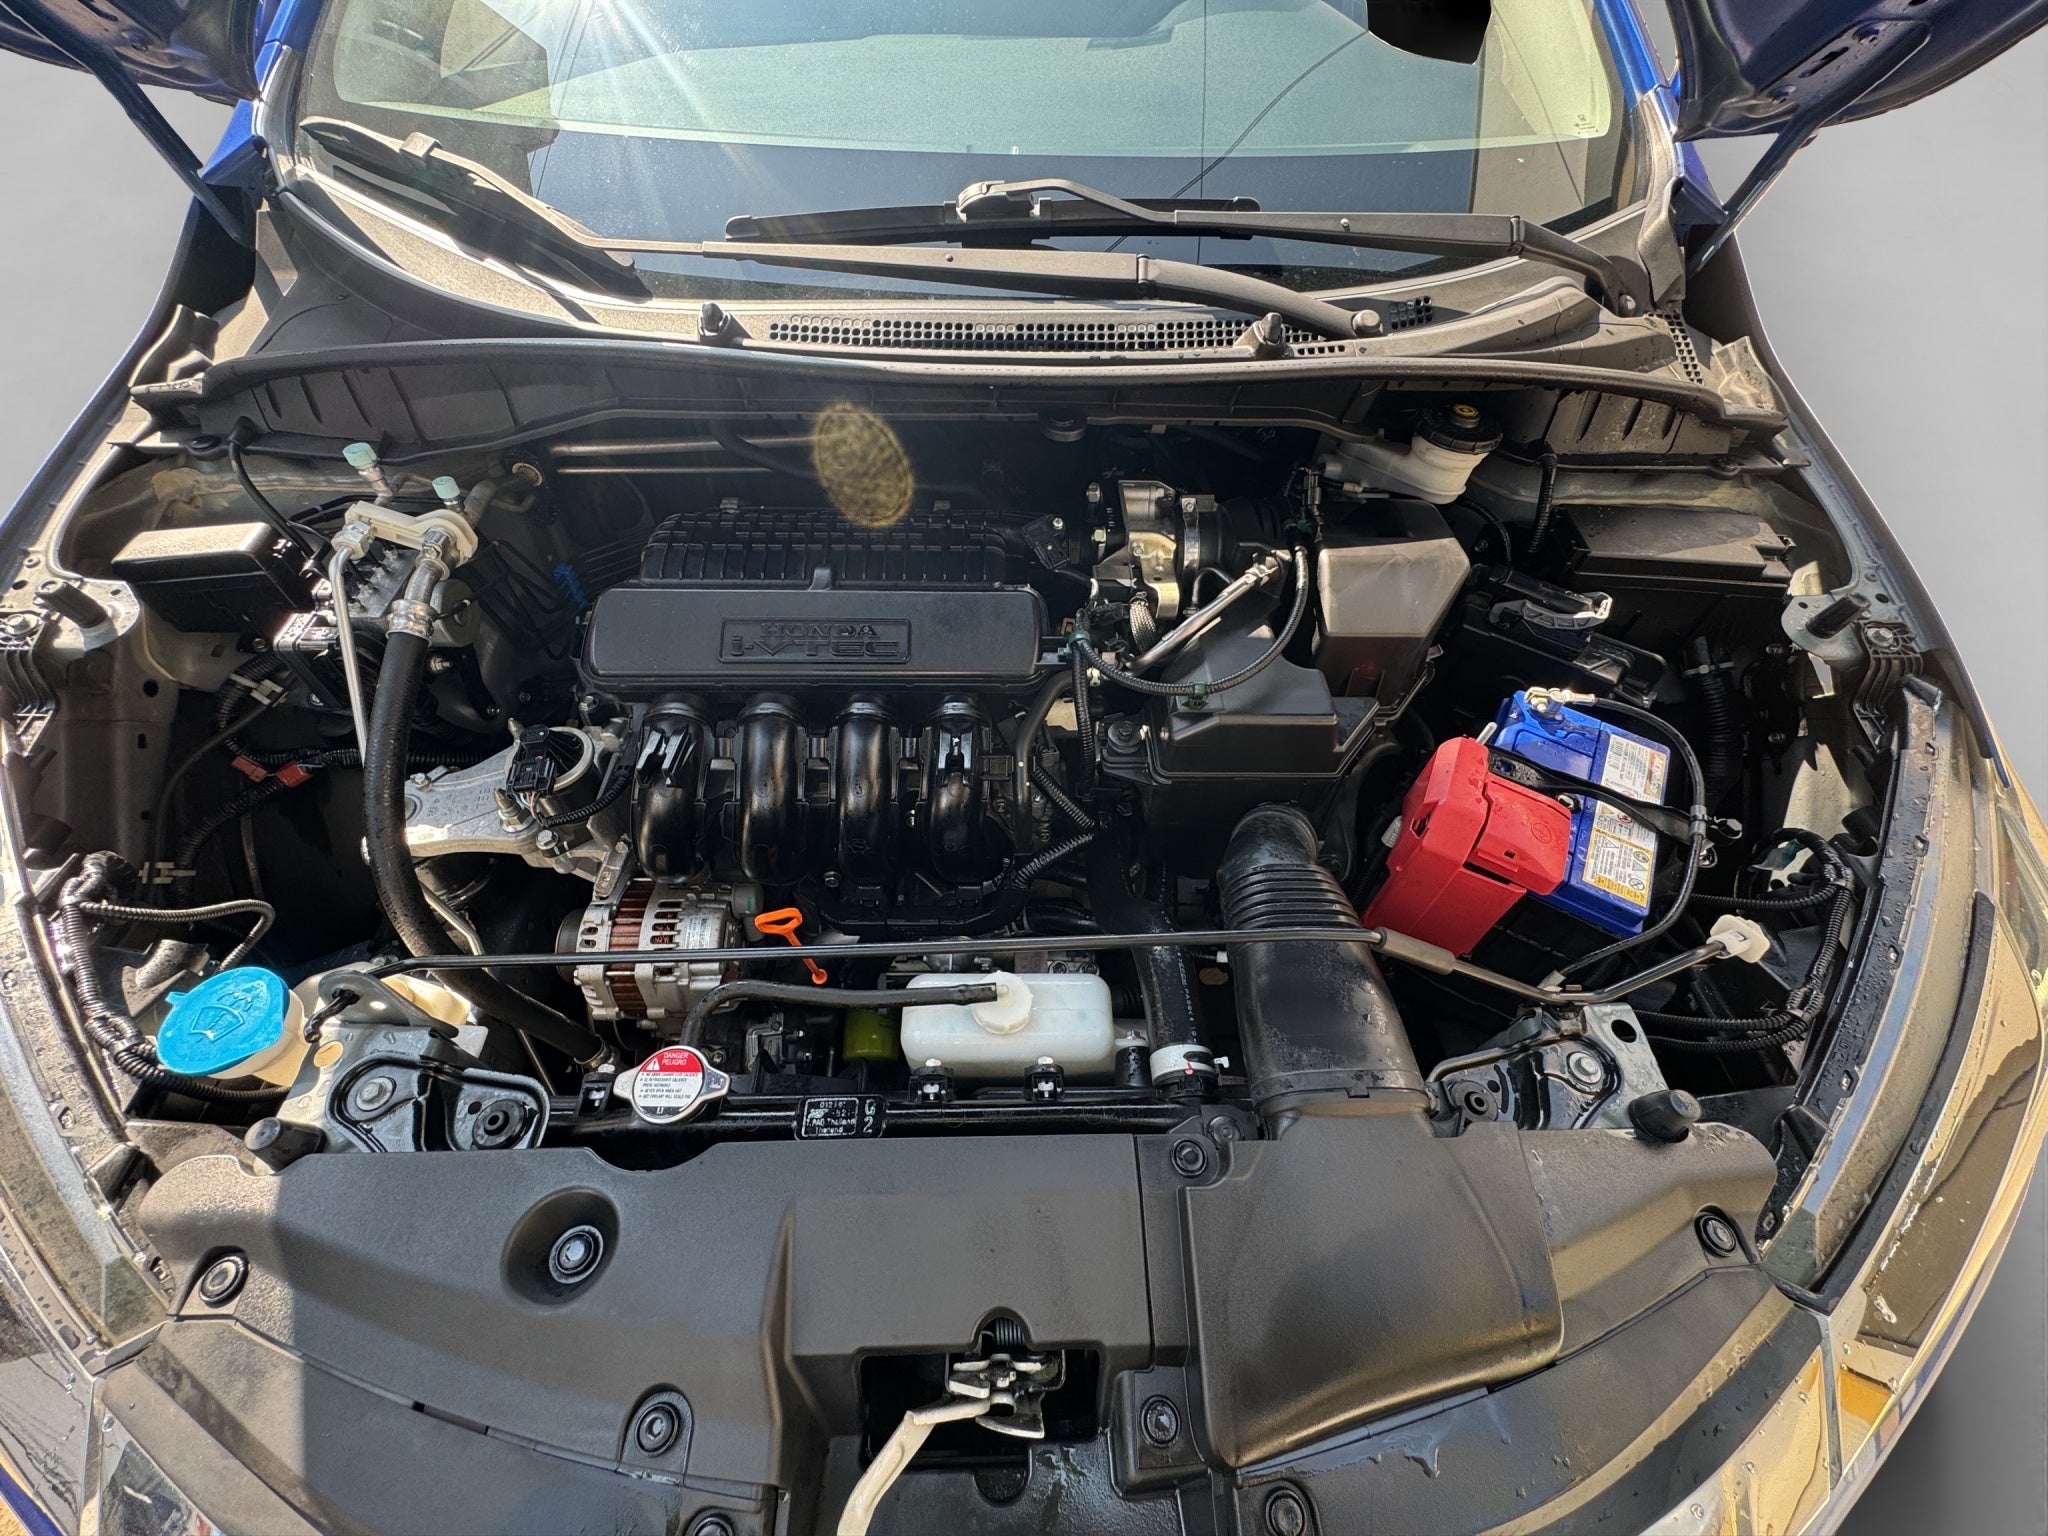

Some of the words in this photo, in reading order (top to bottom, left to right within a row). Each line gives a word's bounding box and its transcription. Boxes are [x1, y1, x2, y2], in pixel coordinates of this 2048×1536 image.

[760, 623, 880, 638] HONDA
[731, 635, 899, 656] i-VTEC
[661, 1058, 687, 1066] PELIGRO
